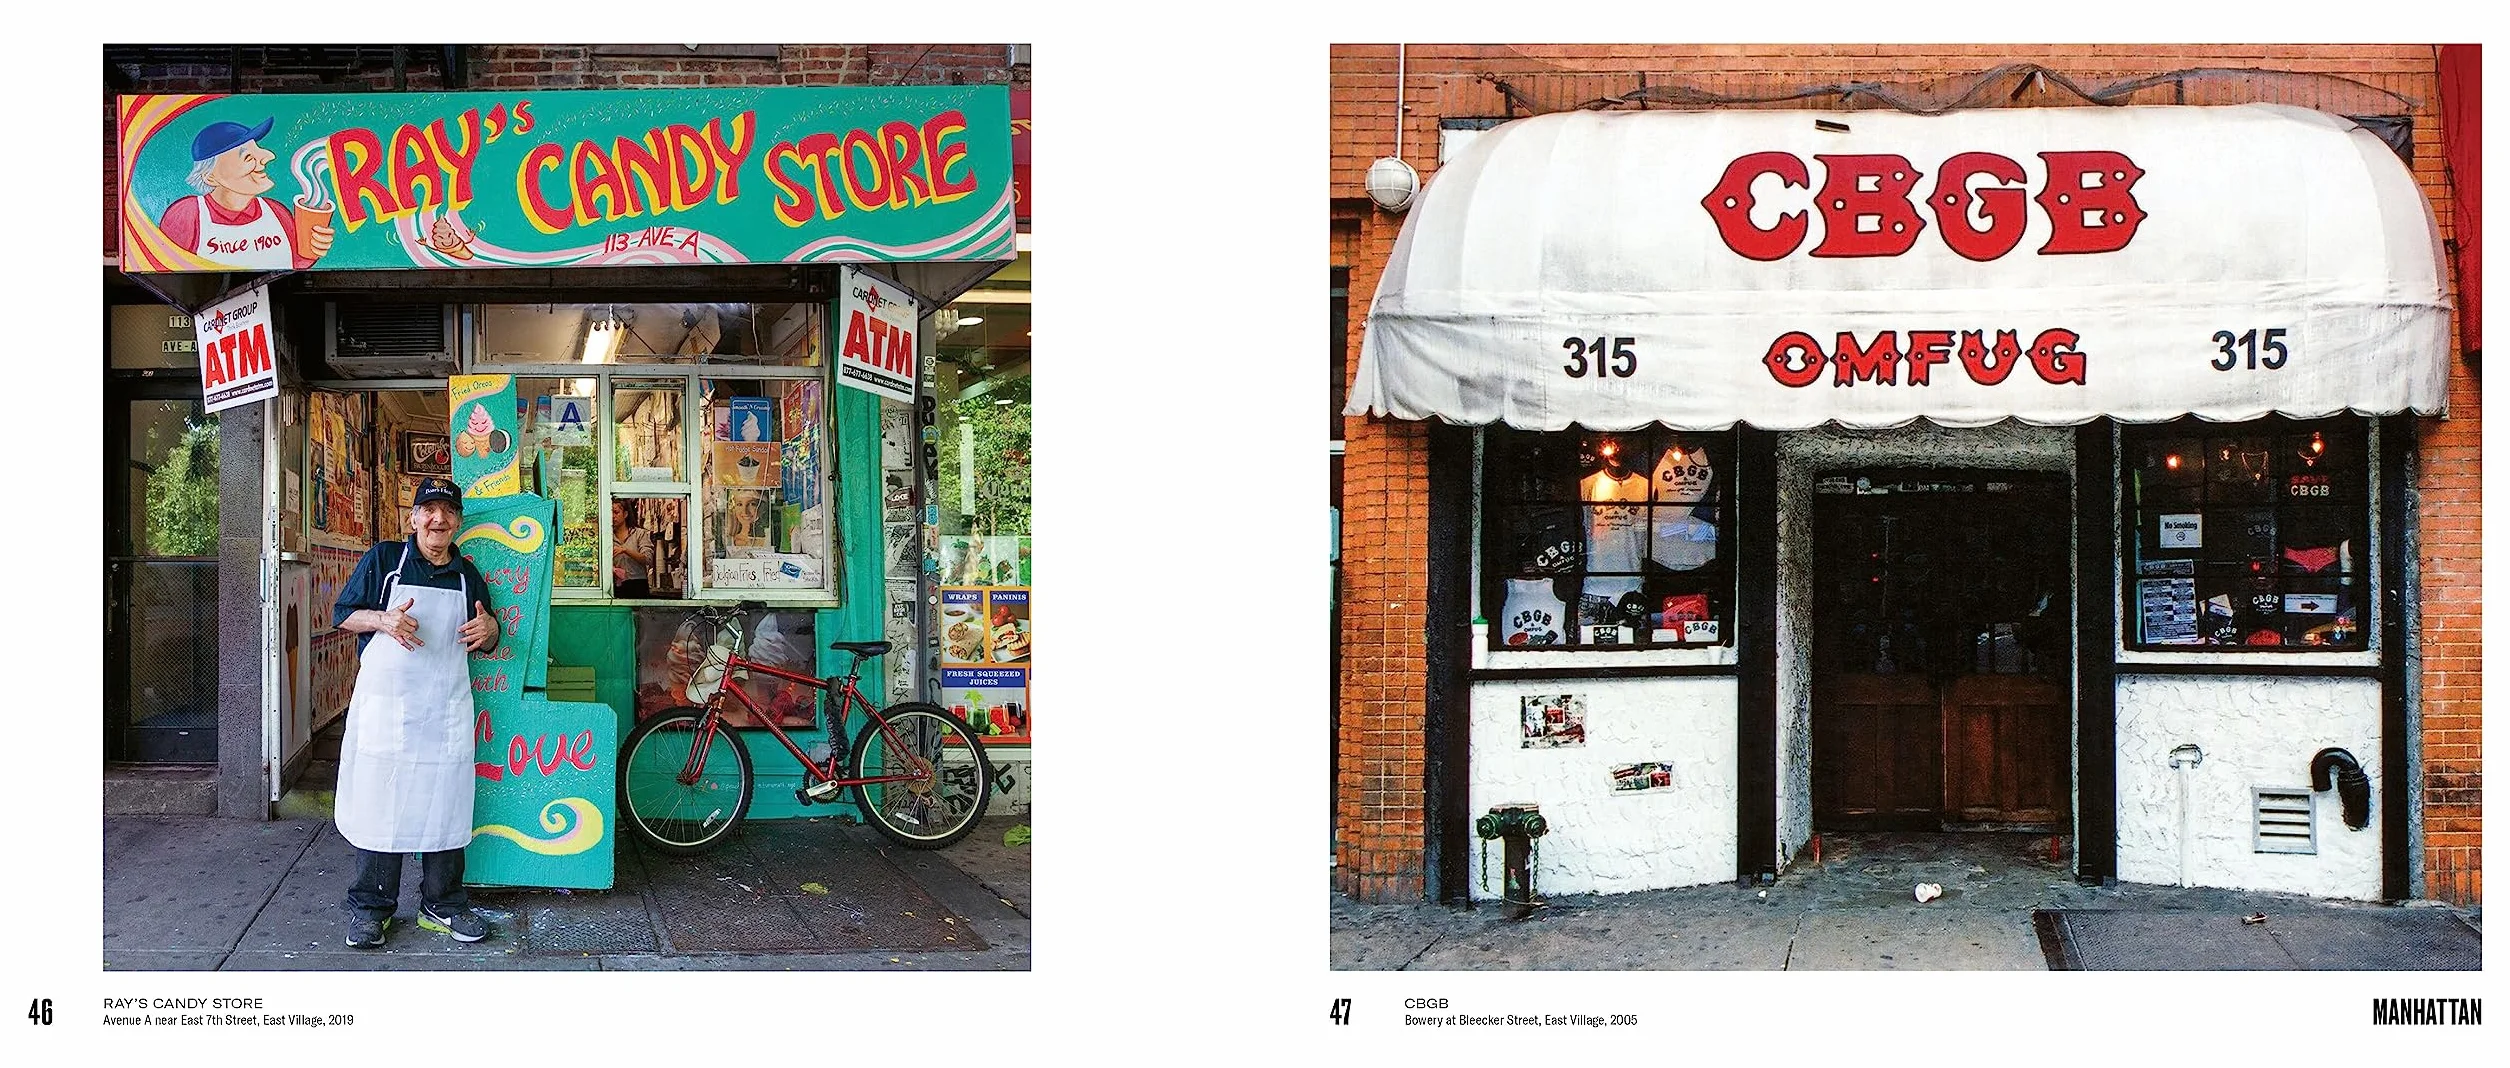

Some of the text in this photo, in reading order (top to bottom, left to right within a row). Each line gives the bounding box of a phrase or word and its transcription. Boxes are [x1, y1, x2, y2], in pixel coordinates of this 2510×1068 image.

[326, 100, 978, 235] RAY'S CANDY STORE
[1701, 151, 2147, 262] CBGB
[206, 235, 282, 254] Since 1900
[604, 227, 700, 258] 113 AVE A
[232, 301, 258, 321] GROUP
[170, 316, 190, 327] 113
[843, 309, 913, 379] ATM
[205, 322, 272, 390] ATM
[1562, 328, 2288, 388] 315 OMFUG 315
[451, 380, 493, 400] Fried Oreos
[557, 402, 585, 432] A
[1661, 465, 1709, 482] CBGB
[474, 474, 511, 496] & Friends
[2290, 485, 2330, 497] CBGB
[2164, 521, 2198, 531] No Smoking
[714, 564, 739, 586] Belgian
[2252, 594, 2280, 606] CBGB
[1513, 609, 1552, 629] CBGB
[1685, 621, 1717, 635] CBGB
[1594, 626, 1618, 637] CBGB
[2214, 627, 2238, 638] CBGB
[969, 678, 999, 686] JUICES
[977, 670, 1021, 678] SQUEEZED
[474, 709, 598, 782] Love
